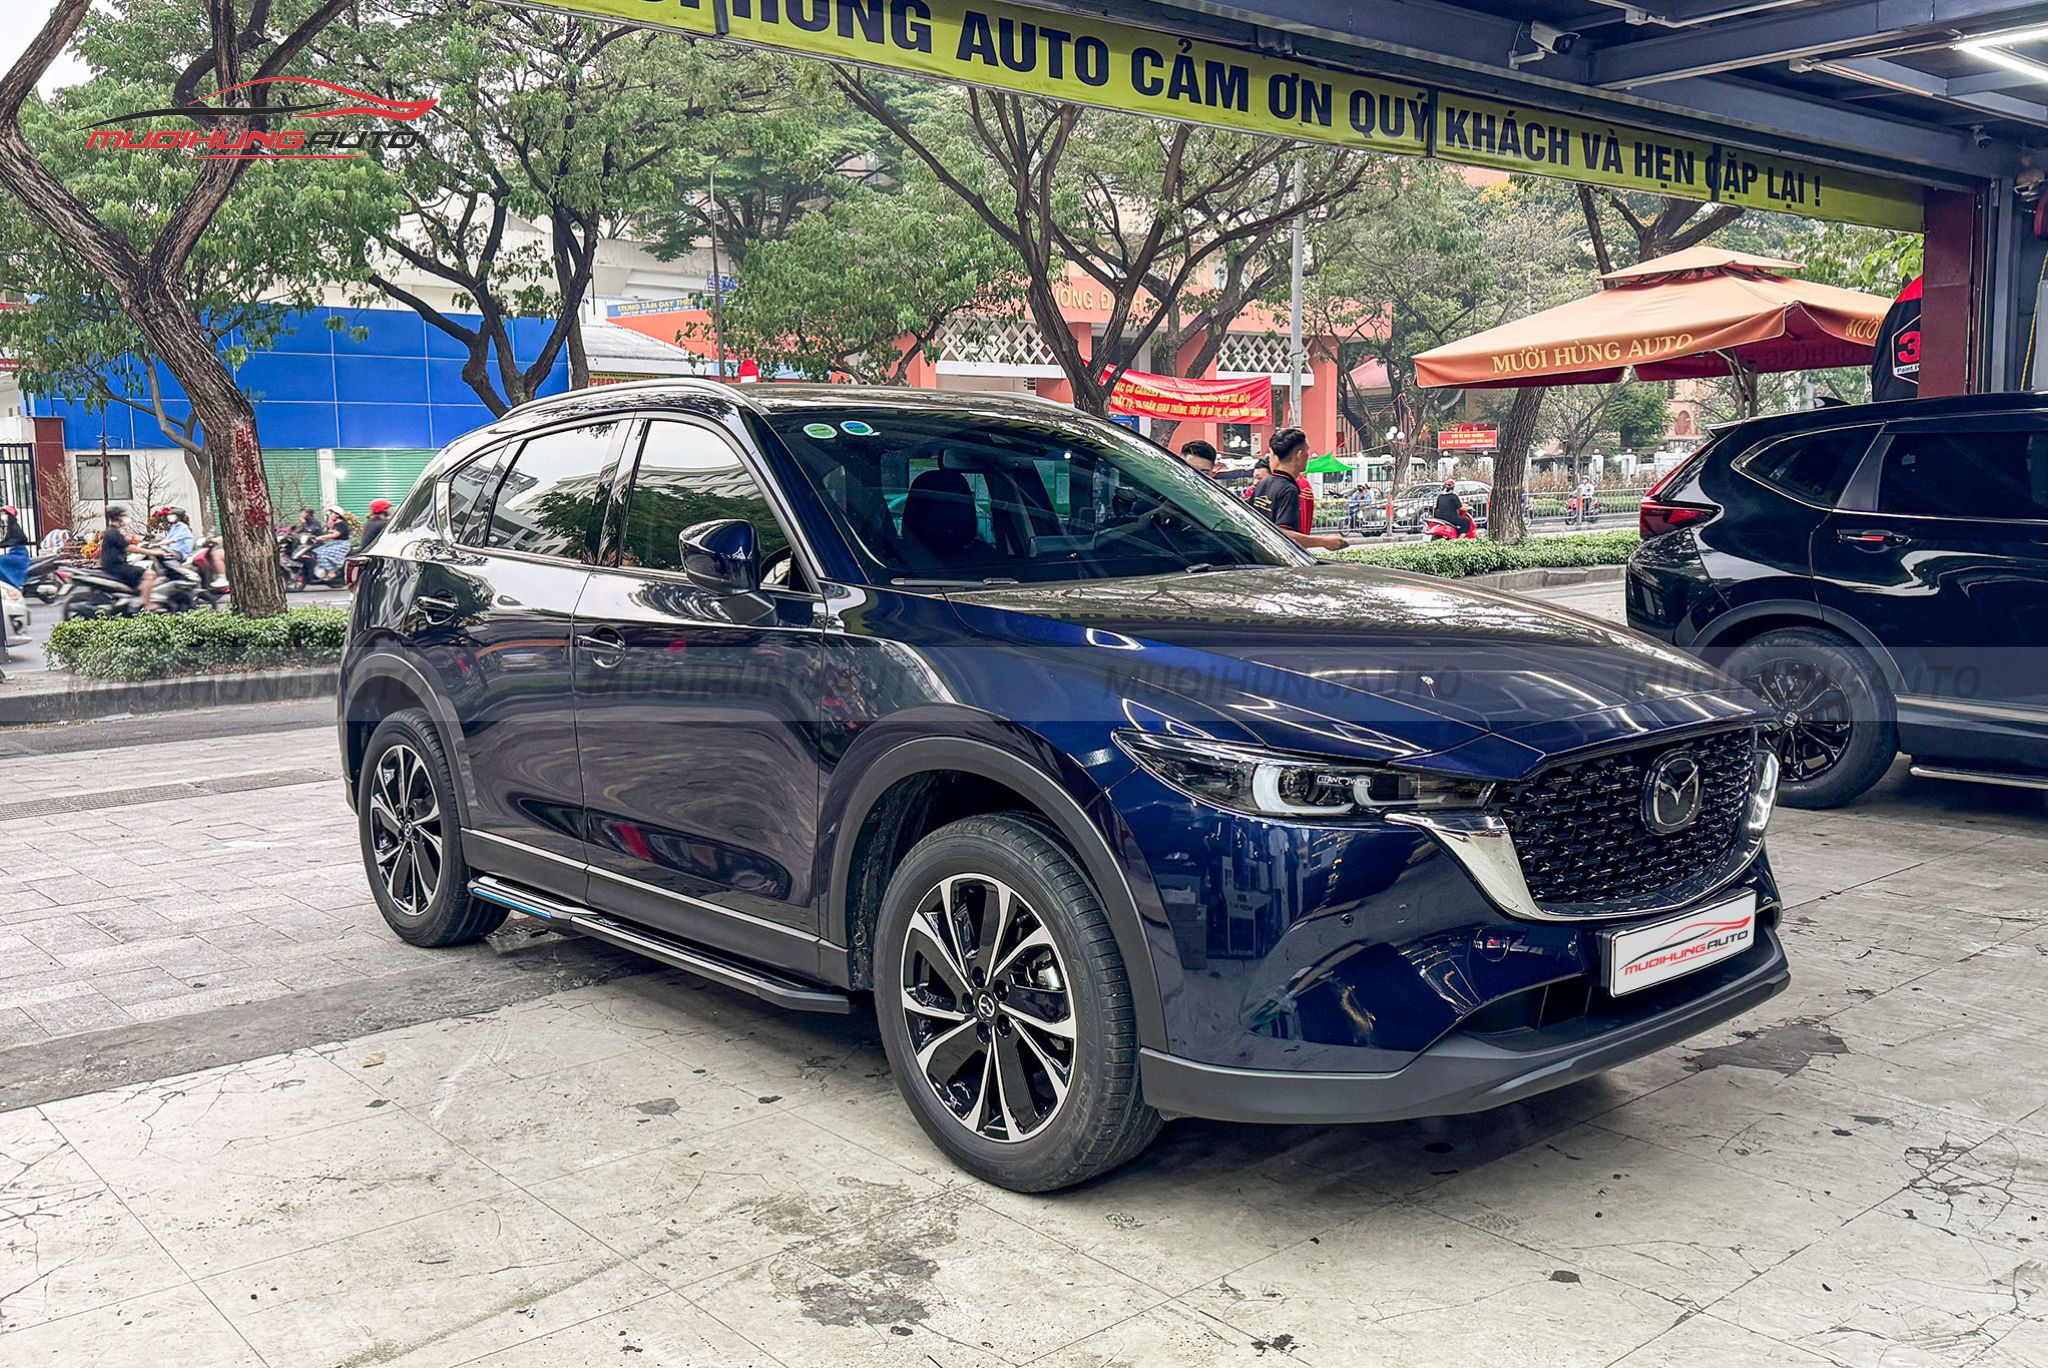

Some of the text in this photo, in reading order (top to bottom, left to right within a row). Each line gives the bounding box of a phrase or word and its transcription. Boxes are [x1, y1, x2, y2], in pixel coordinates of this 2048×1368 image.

[955, 10, 1110, 87] AUTO
[1131, 38, 1249, 112] CẢM
[1268, 72, 1333, 127] ƠN
[1349, 90, 1429, 142] QUÝ
[1446, 107, 1570, 166] KHÁCH
[1581, 128, 1624, 175] VÀ
[1634, 141, 1695, 189] HẸN
[1767, 165, 1805, 209] LẠI
[1492, 333, 1694, 374] MƯỜI HÙNG AUTO
